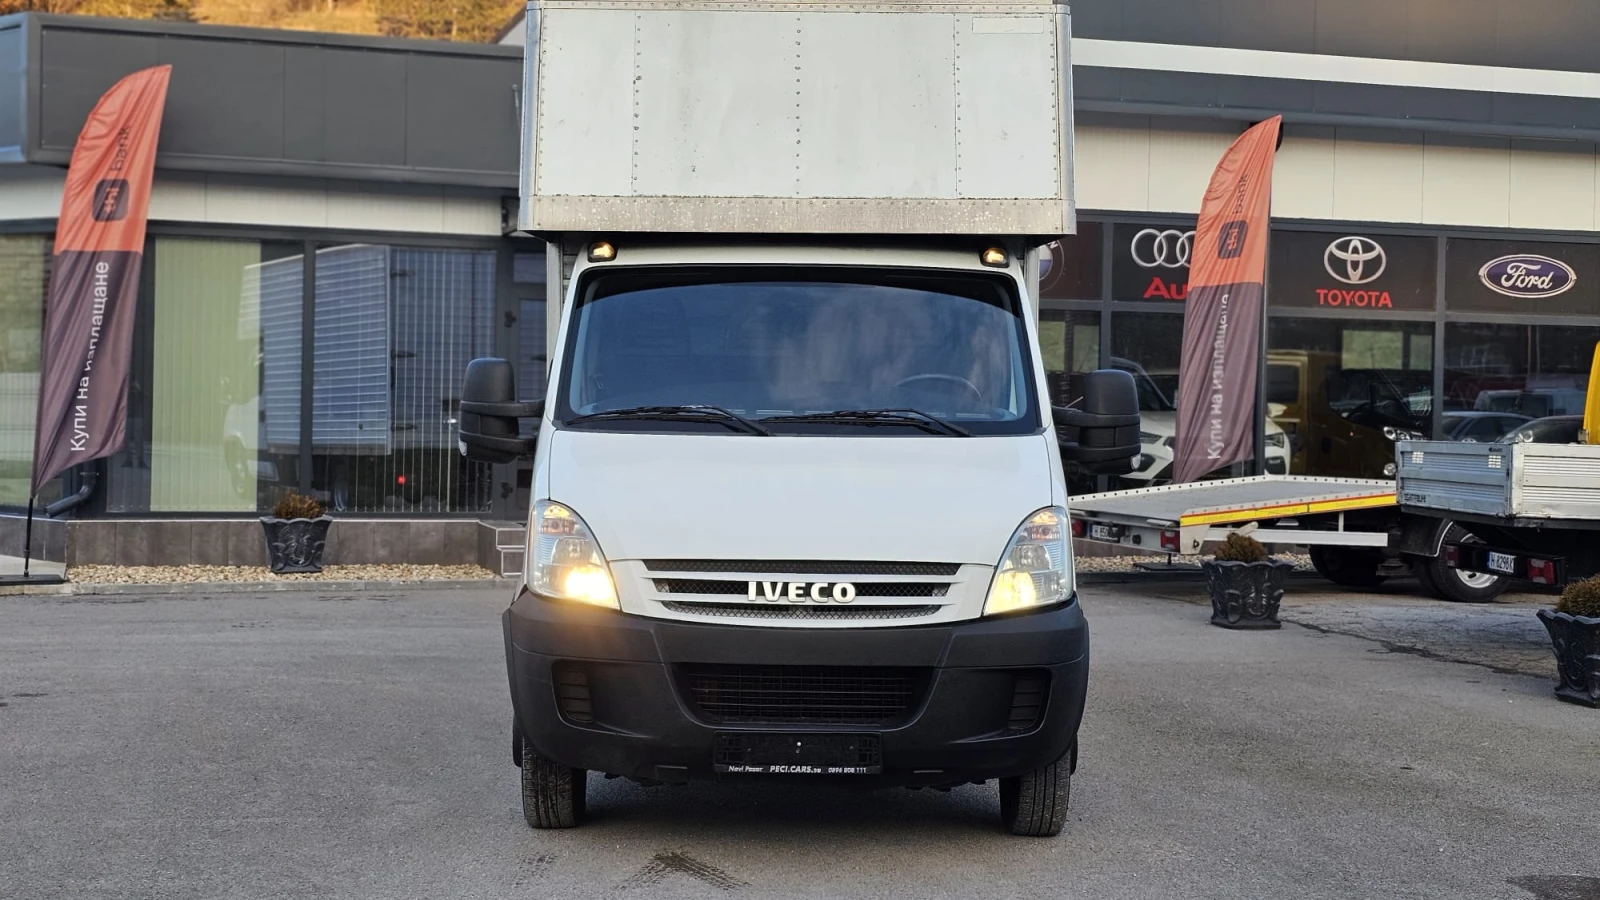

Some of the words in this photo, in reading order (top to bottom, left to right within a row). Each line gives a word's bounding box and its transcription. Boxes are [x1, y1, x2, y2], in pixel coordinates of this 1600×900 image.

[1501, 262, 1554, 289] Ford
[1143, 276, 1188, 300] Au
[1316, 289, 1393, 308] TOYOTA
[84, 262, 109, 371] изплащане
[77, 376, 89, 399] на
[1211, 394, 1223, 414] на
[70, 405, 89, 451] Купи
[1207, 419, 1225, 459] Купи
[747, 581, 856, 603] IVECO
